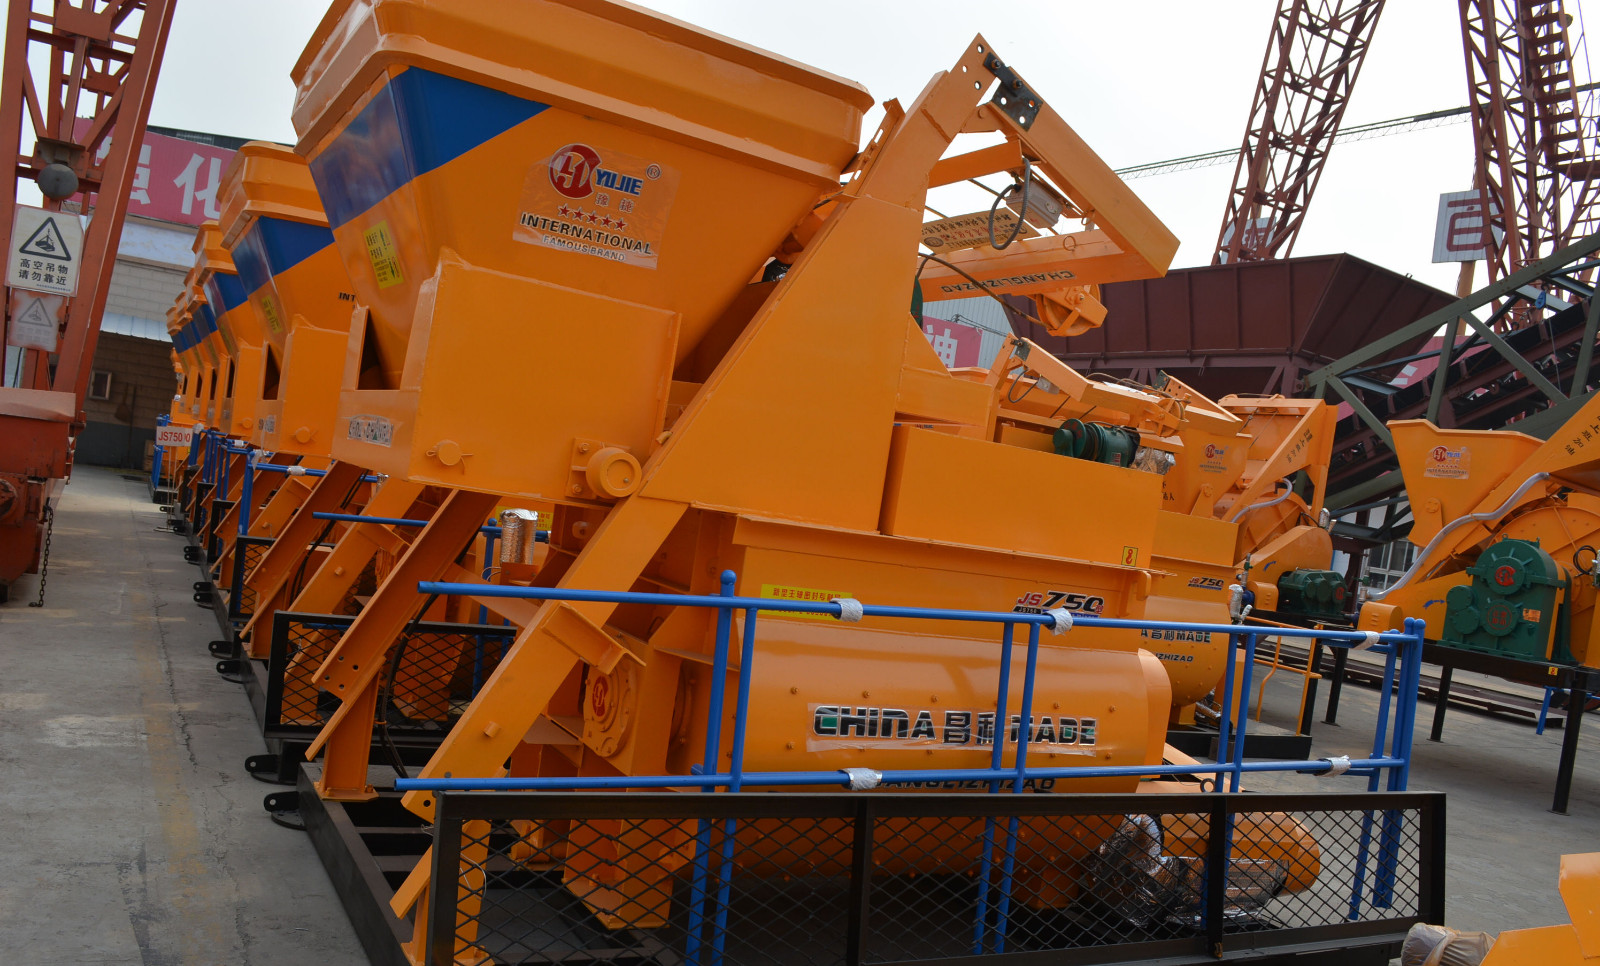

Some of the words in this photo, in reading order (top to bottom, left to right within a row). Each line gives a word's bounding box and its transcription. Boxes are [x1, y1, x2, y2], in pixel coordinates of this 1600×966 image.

[595, 168, 643, 196] YUJIE
[520, 212, 653, 256] INTERNATIONAL
[542, 234, 589, 254] FAMOUS
[589, 245, 626, 262] BRAND
[18, 269, 67, 286] 请勿靠近
[20, 258, 69, 275] 高空吊物
[158, 431, 183, 442] JS750
[1176, 631, 1211, 643] MADE
[813, 705, 937, 741] CHINA
